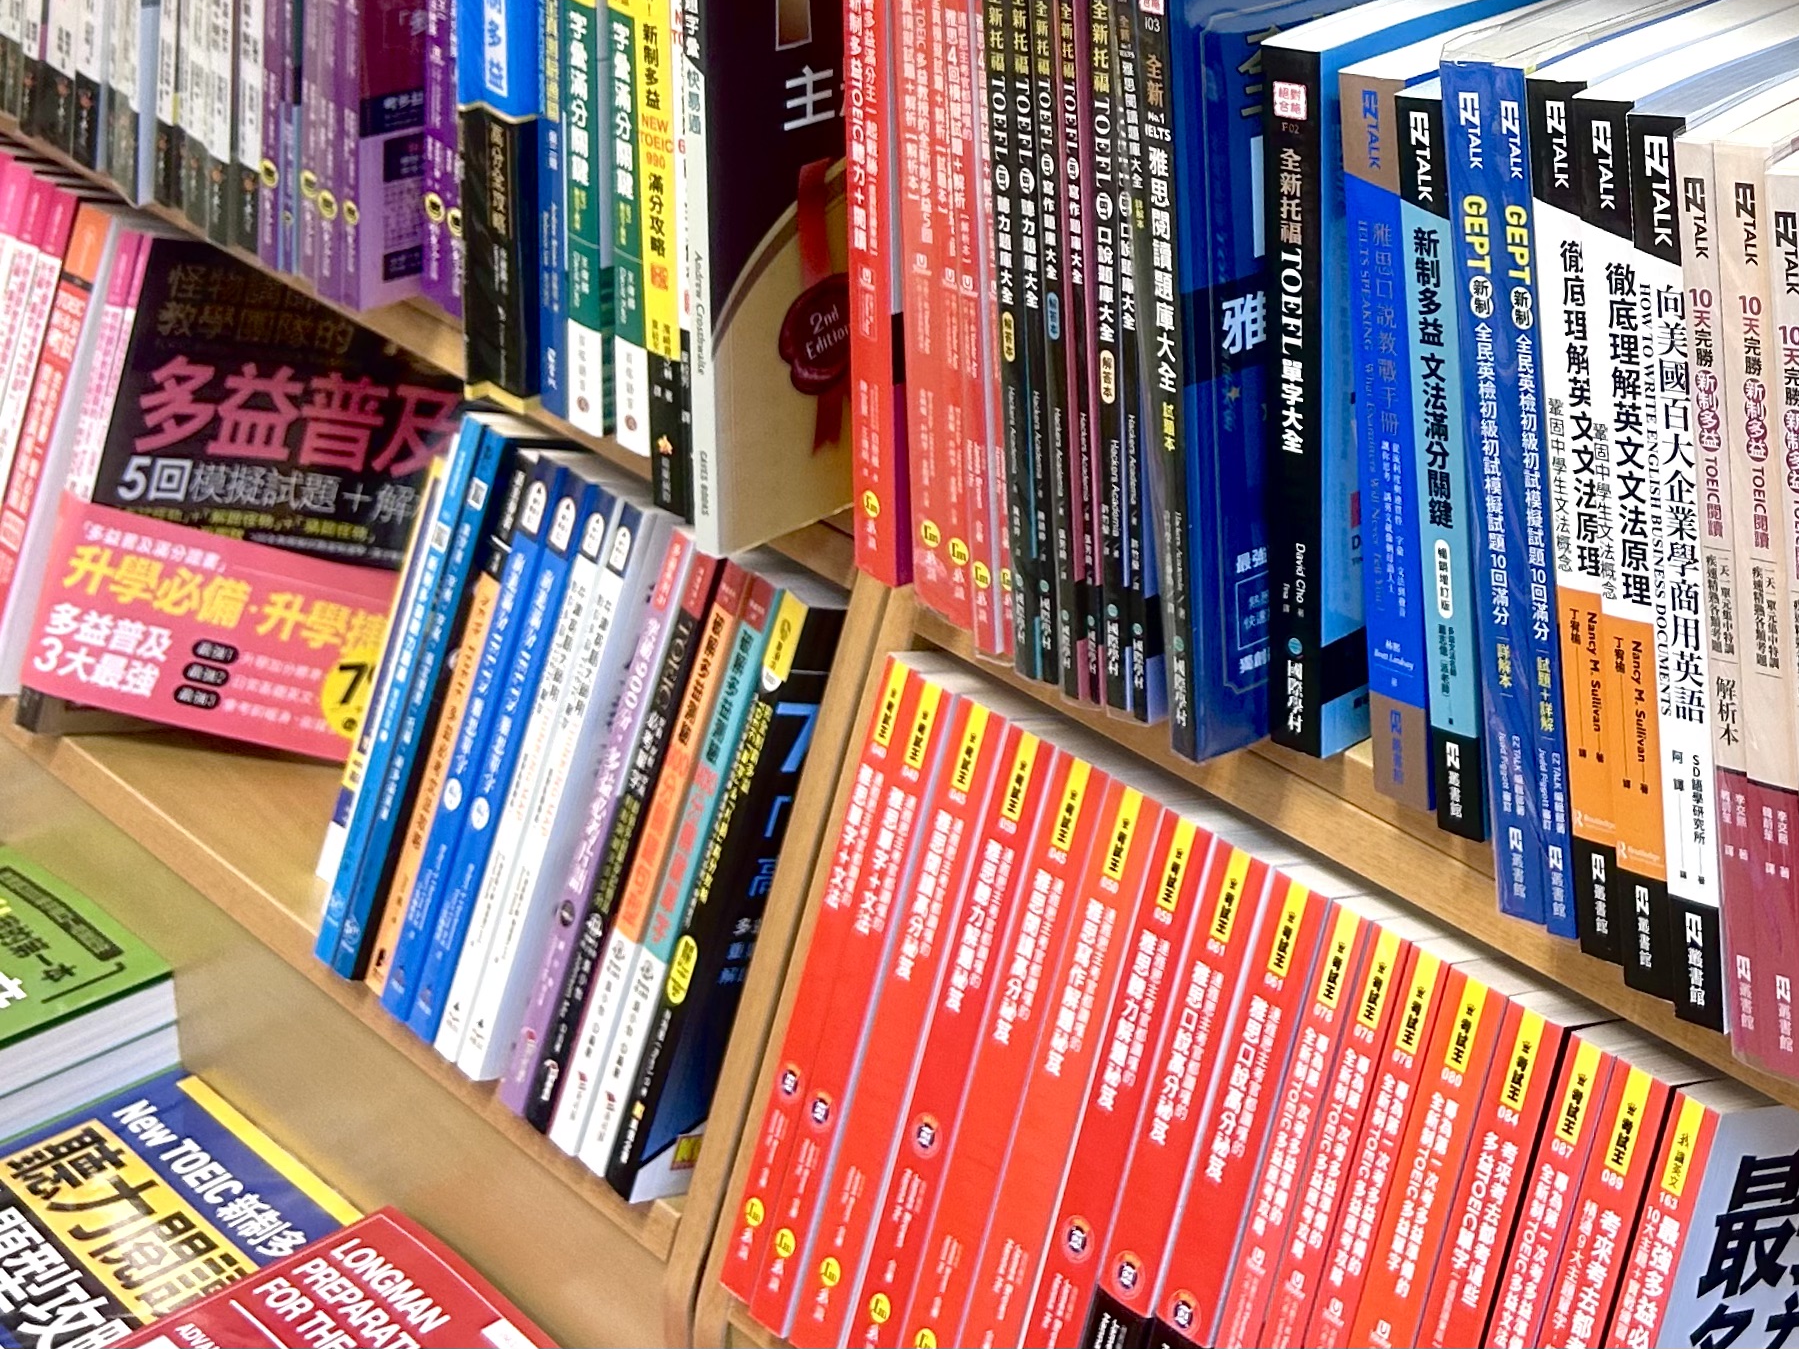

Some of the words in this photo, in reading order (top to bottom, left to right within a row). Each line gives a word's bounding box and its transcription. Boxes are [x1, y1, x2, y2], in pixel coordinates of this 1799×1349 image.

[640, 23, 661, 110] 新制多益
[639, 133, 674, 153] TOEIC
[641, 113, 670, 133] NEW
[1144, 123, 1172, 141] IELTS
[1279, 147, 1302, 244] 全新托福
[1462, 194, 1492, 274] GEPT
[810, 306, 840, 334] 2nd
[1279, 248, 1303, 357] TOEFL
[1412, 227, 1446, 349] 新制多益
[1419, 352, 1454, 529] 文法滿分關鍵
[112, 1099, 164, 1148] New
[160, 1136, 243, 1206] TOEIC
[1497, 1106, 1520, 1127] 084
[1658, 1190, 1679, 1210] 163
[253, 1278, 303, 1324] FOR
[331, 1237, 451, 1333] LONGMAN
